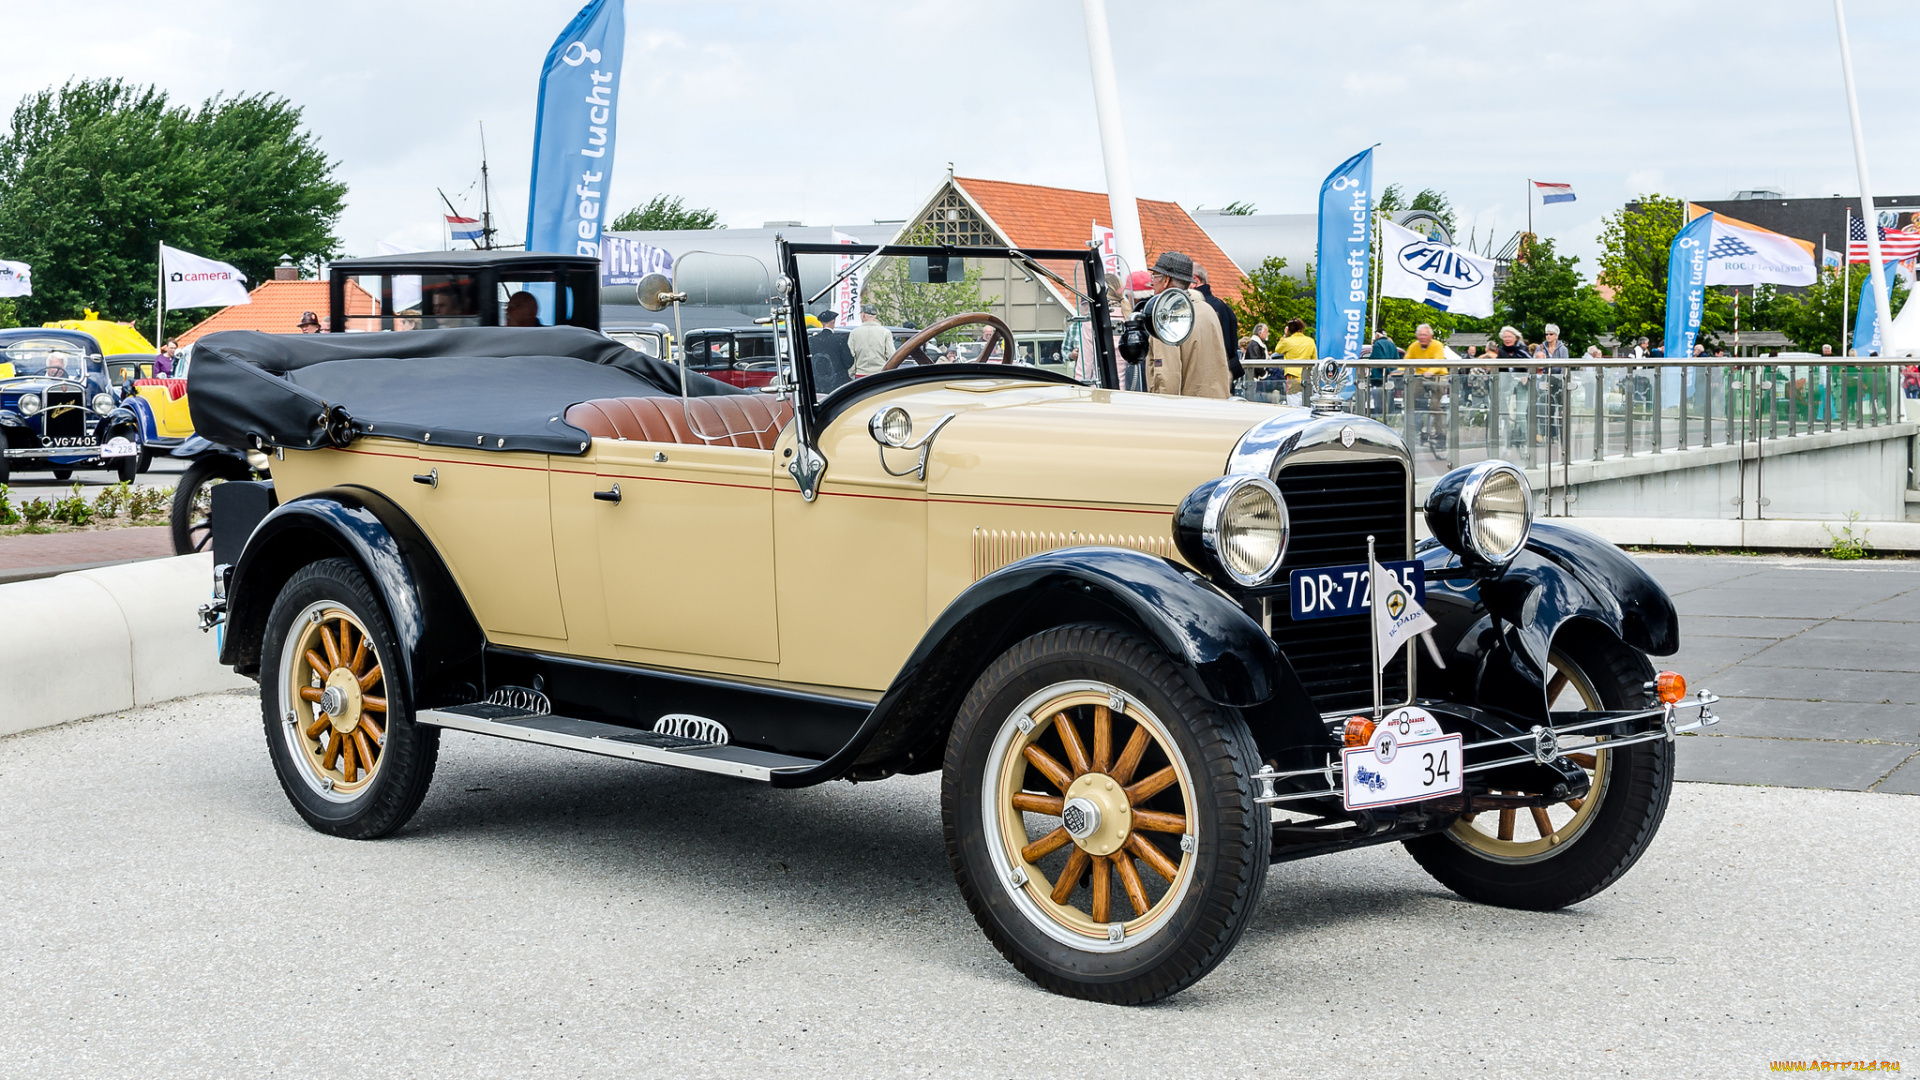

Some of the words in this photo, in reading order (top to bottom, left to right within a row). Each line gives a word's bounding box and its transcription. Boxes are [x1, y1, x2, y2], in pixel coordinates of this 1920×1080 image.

[581, 69, 613, 158] lucht
[576, 170, 603, 257] geeft
[1348, 190, 1366, 242] lucht
[609, 237, 665, 275] FLEVO
[1403, 248, 1475, 283] FAIR
[1690, 248, 1705, 285] lucht
[1724, 262, 1747, 270] ROC
[1751, 263, 1804, 273] Flevoland
[1348, 250, 1366, 302] geeft
[1688, 289, 1700, 327] geeft
[53, 436, 97, 447] VG-74-05
[118, 445, 133, 454] 228
[1422, 750, 1450, 786] 34
[1064, 810, 1079, 832] ESSEX
